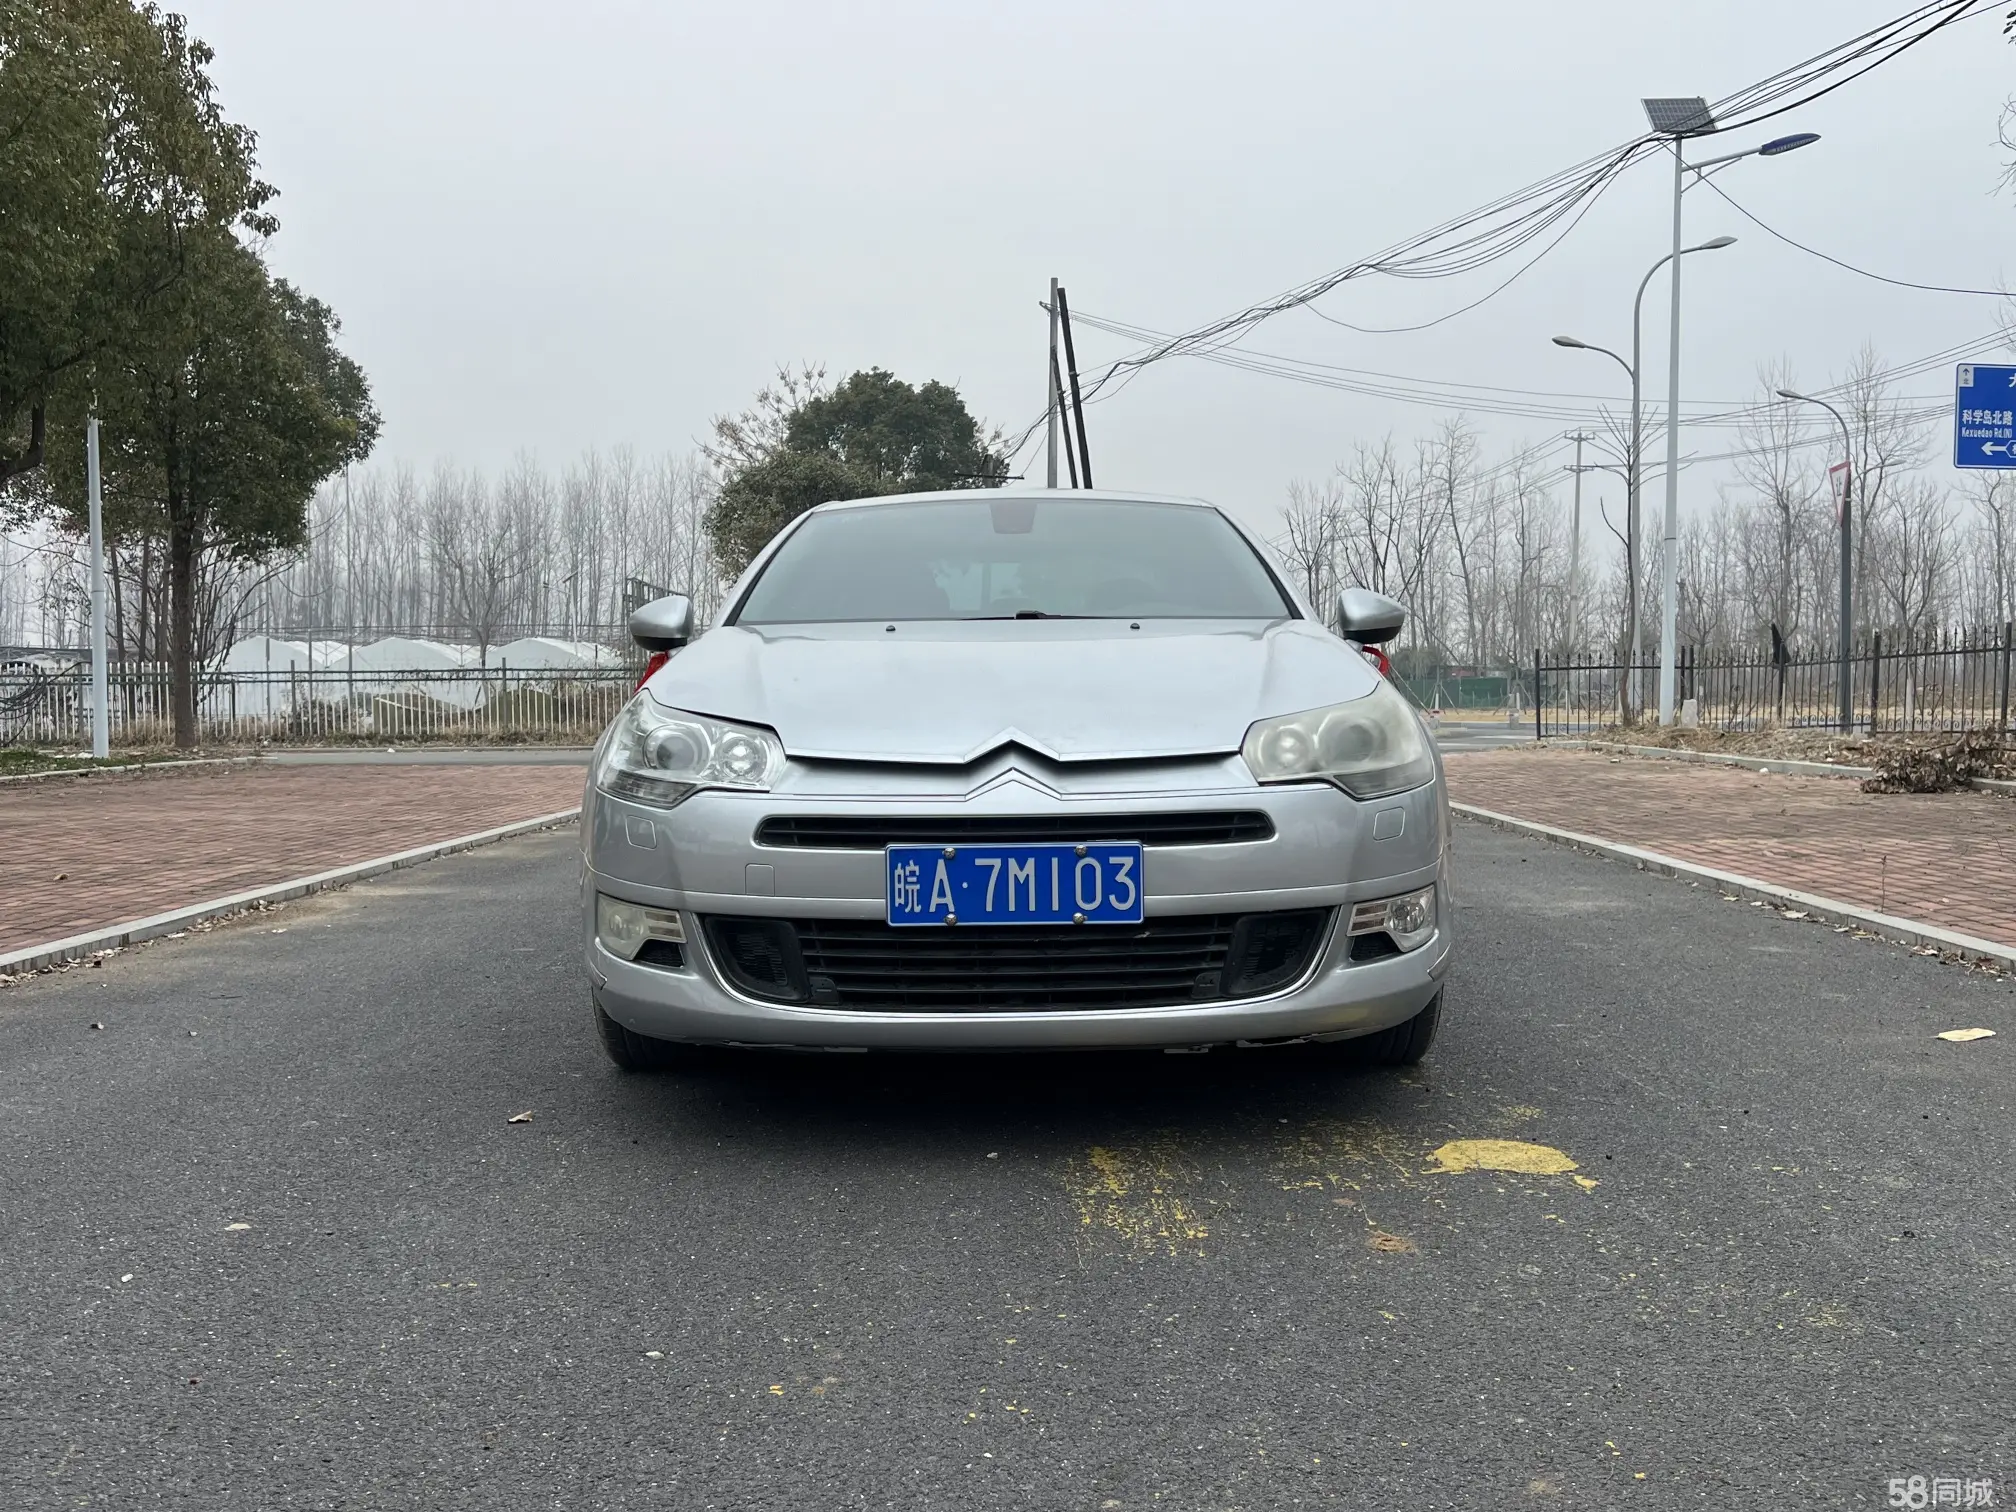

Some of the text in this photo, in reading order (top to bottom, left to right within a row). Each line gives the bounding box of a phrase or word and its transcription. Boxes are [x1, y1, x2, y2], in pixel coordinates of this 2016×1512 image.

[1962, 409, 2013, 426] 科学岛北路
[1961, 426, 1993, 438] Kexuedao
